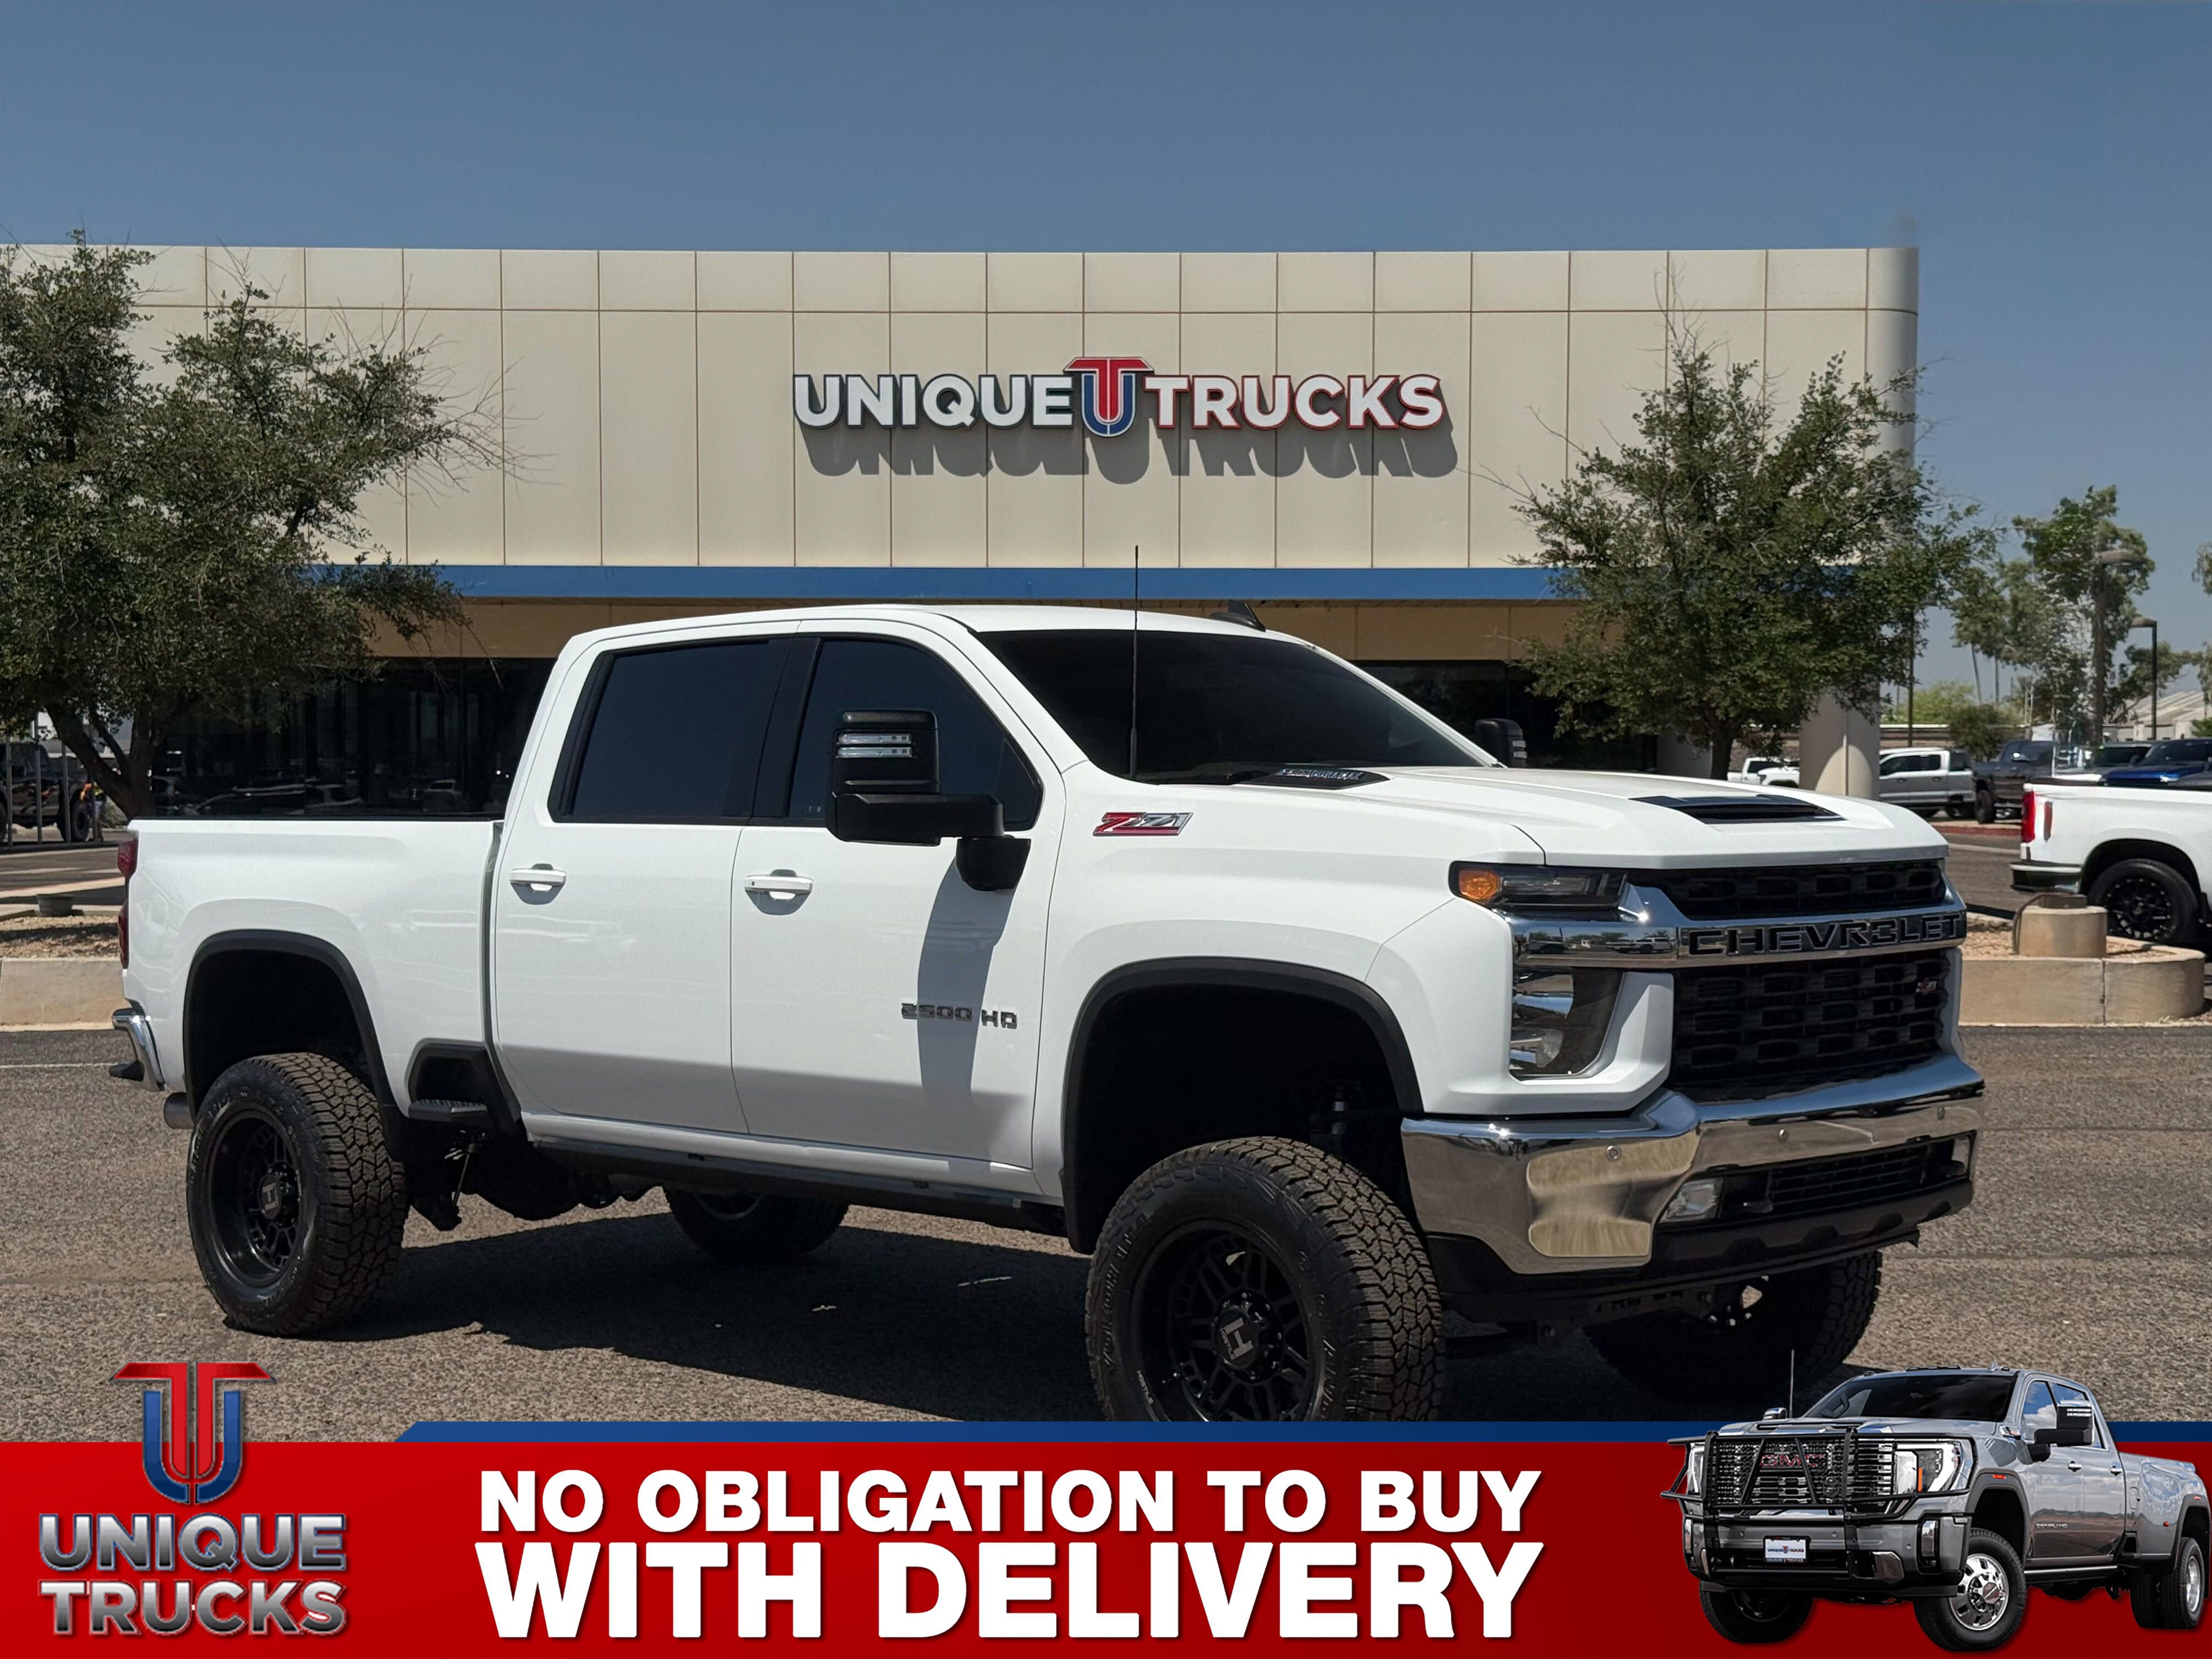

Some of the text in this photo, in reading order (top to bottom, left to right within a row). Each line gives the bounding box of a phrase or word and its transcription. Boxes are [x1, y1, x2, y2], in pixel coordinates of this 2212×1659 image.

[793, 374, 1074, 429] UNIQUE
[1142, 374, 1445, 430] TRUCKS
[1092, 812, 1193, 836] Z71
[1688, 912, 1962, 956] CHEVROLET
[901, 1003, 1017, 1030] 2500 HD
